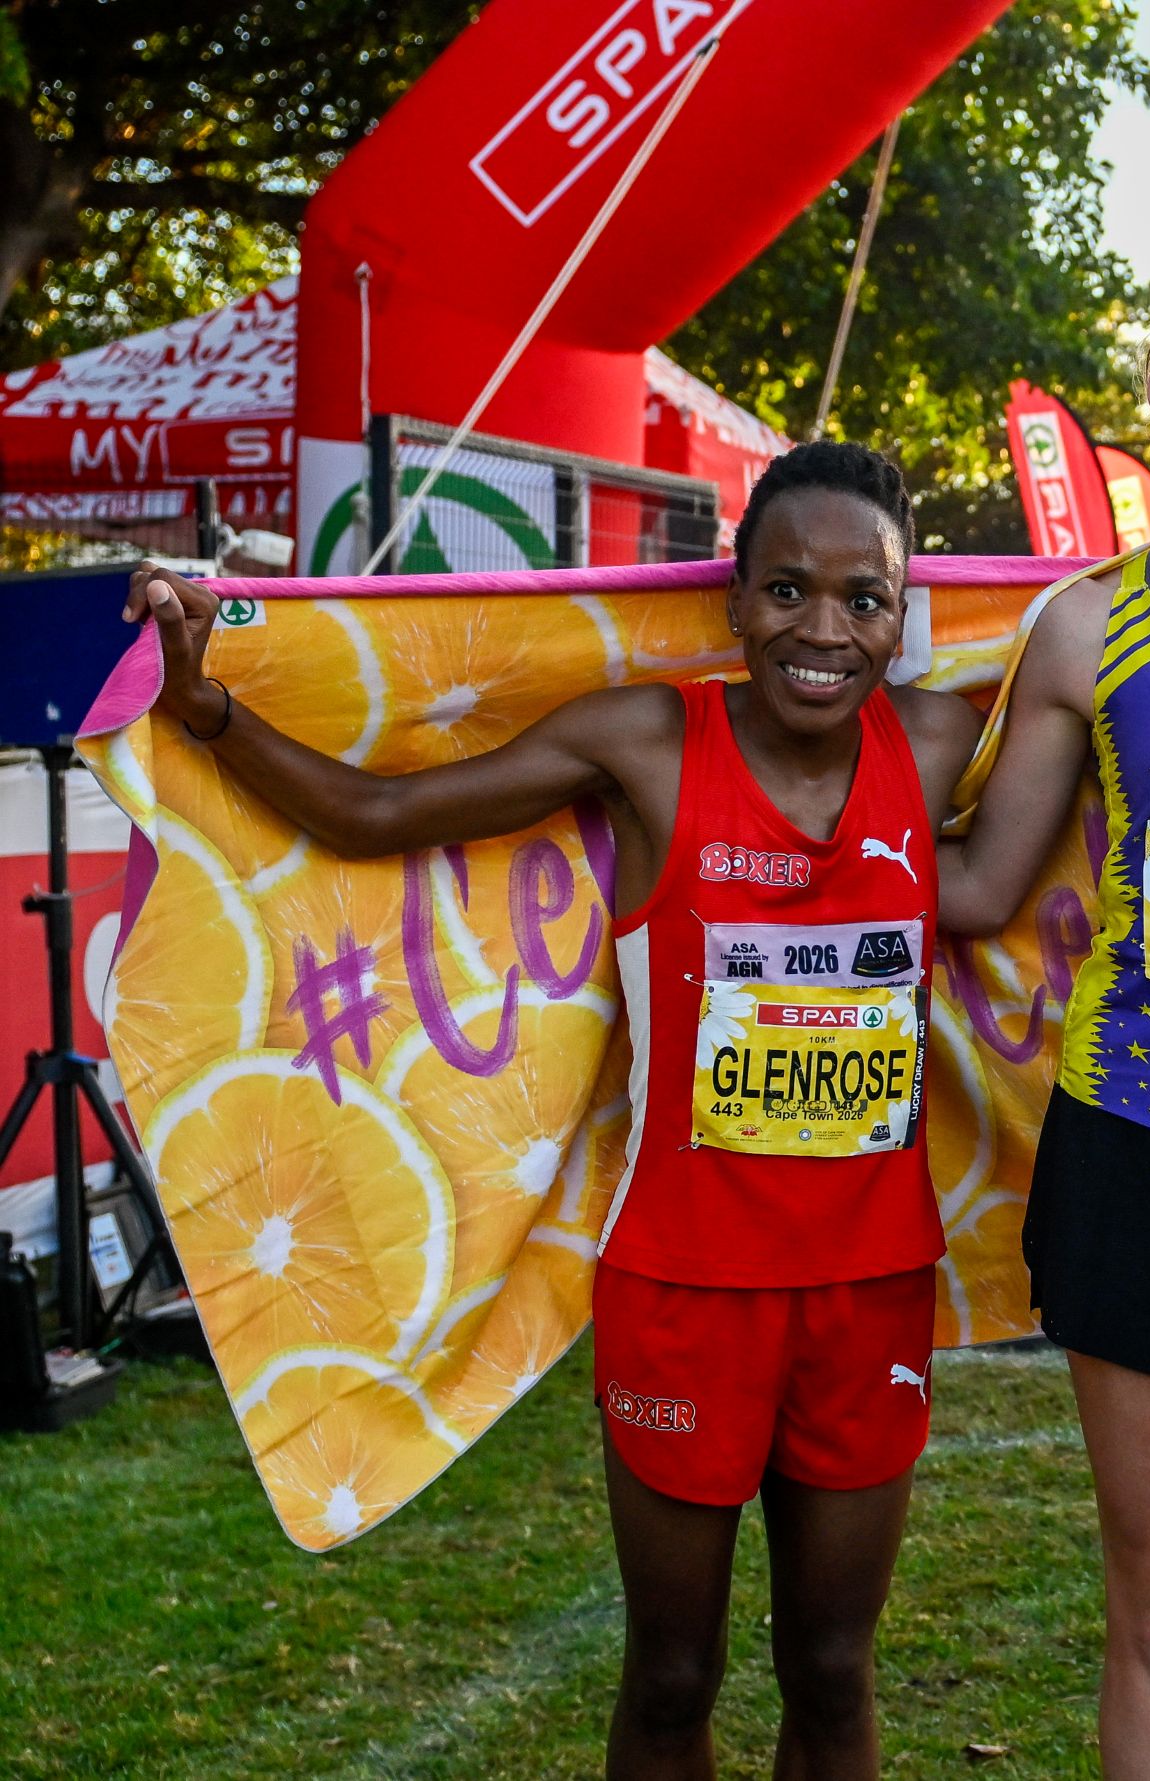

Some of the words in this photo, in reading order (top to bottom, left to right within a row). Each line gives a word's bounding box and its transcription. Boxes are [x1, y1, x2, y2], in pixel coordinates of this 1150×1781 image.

[546, 0, 713, 148] SPA
[70, 423, 160, 482] MY
[699, 842, 811, 887] BOXER
[720, 953, 742, 961] License
[761, 954, 769, 962] by
[730, 942, 759, 954] ASA
[784, 943, 839, 975] 2026
[860, 936, 905, 959] ASA
[726, 961, 763, 978] AGN
[781, 1008, 857, 1024] SPAR
[808, 1036, 836, 1044] 10KM
[712, 1046, 907, 1101] GLENROSE
[914, 1047, 924, 1080] DRAW
[710, 1101, 744, 1117] 443
[910, 1083, 921, 1120] LUCKY
[765, 1110, 798, 1121] Cape
[802, 1110, 834, 1121] Town
[837, 1110, 864, 1121] 2026
[873, 1126, 889, 1135] ASA
